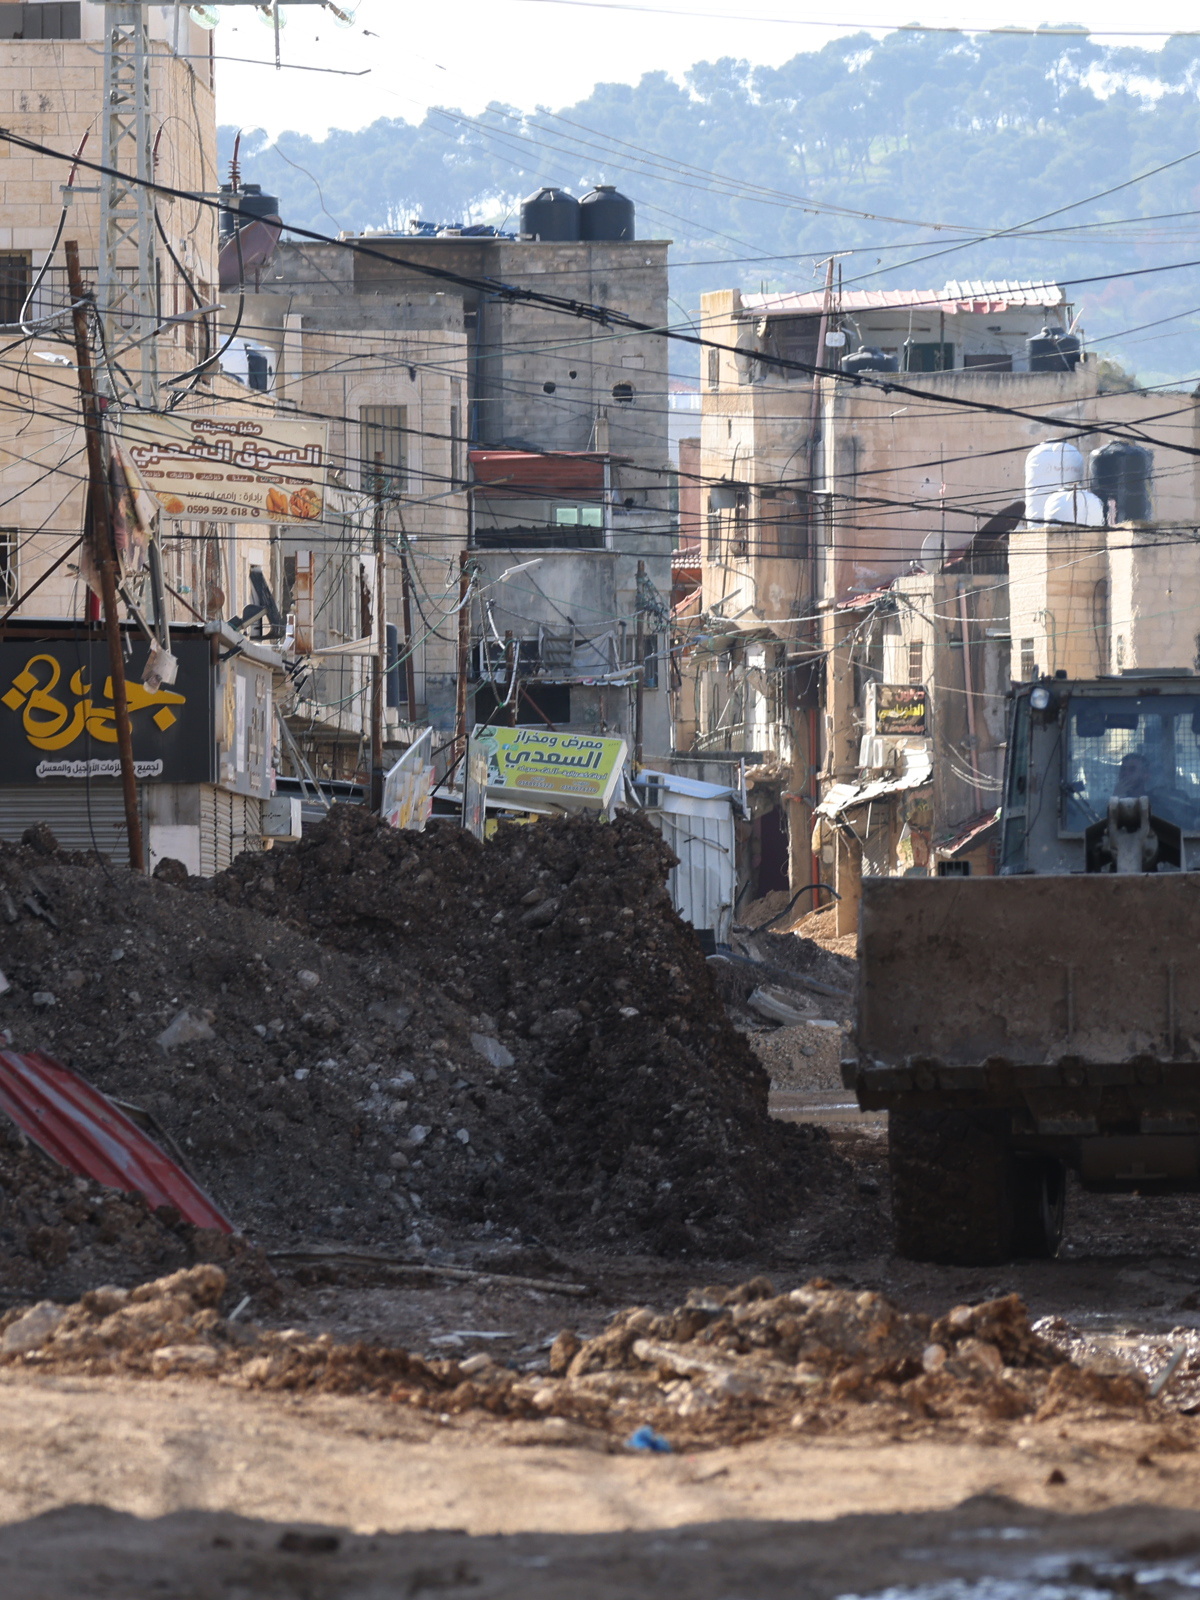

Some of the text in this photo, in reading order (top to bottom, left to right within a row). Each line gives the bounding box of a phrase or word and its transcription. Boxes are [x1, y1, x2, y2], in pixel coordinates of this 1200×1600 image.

[239, 422, 261, 435] مخبز
[131, 437, 320, 468] السوق الشعبي
[187, 504, 248, 516] 0599 592 618
[561, 736, 604, 750] معرض
[504, 750, 603, 769] السعدي
